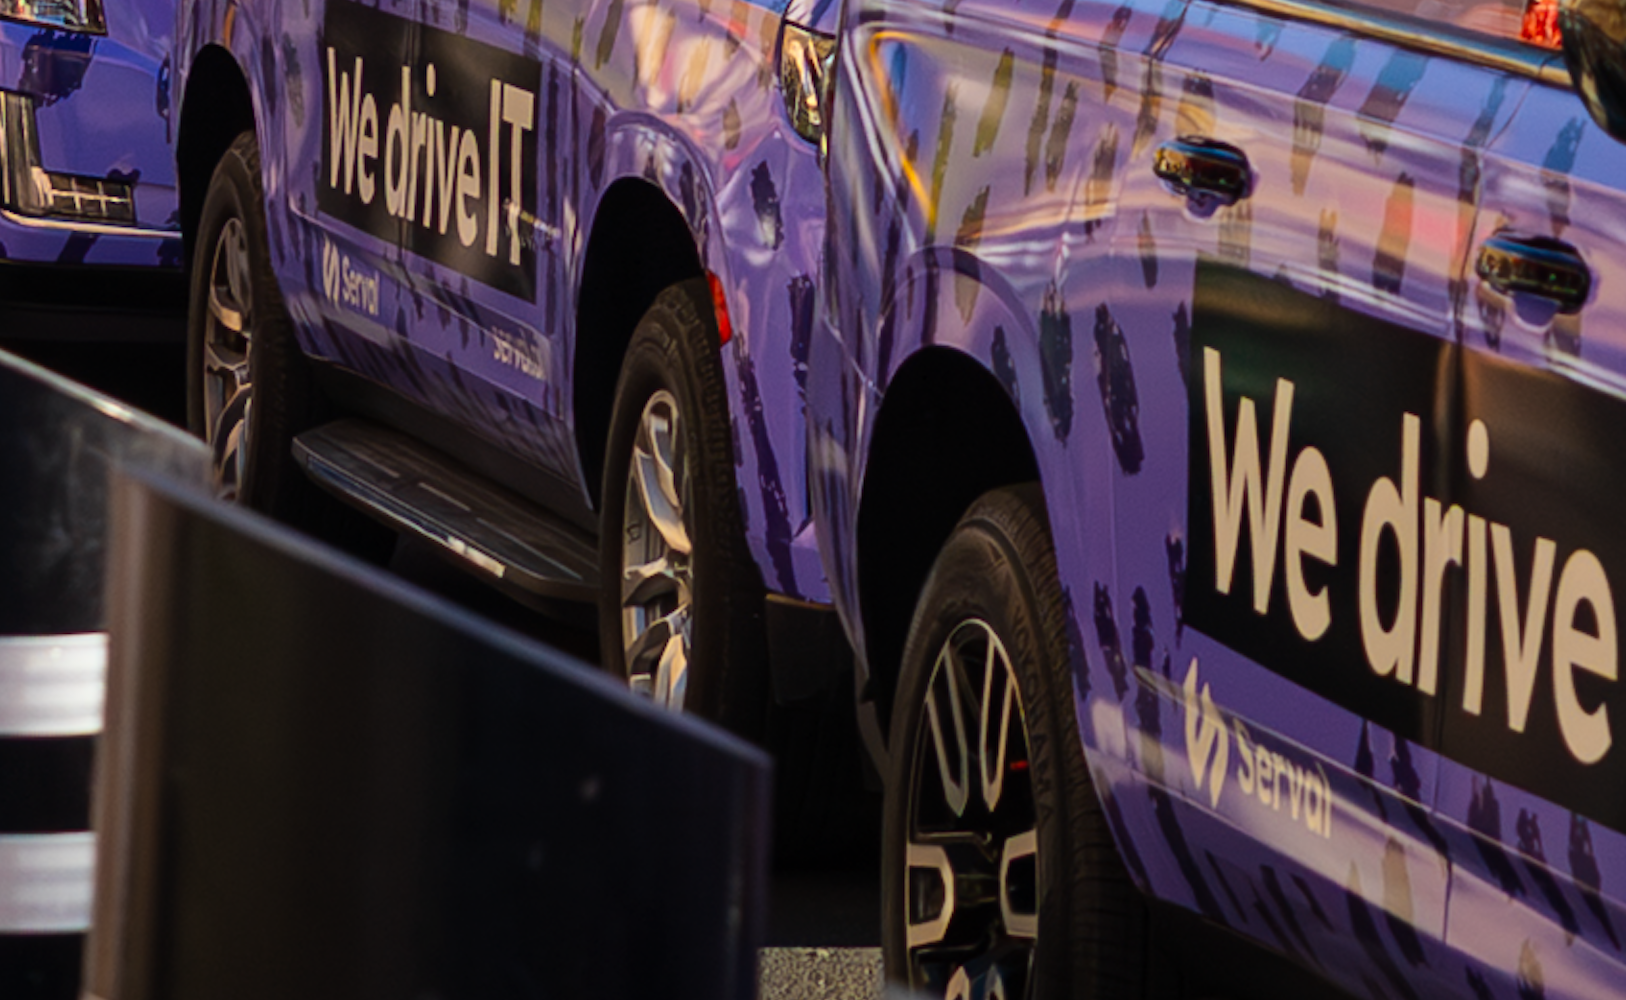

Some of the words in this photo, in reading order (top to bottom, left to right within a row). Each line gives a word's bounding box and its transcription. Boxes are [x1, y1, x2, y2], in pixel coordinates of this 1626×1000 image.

[327, 47, 379, 205] We
[385, 63, 480, 247] drive
[485, 78, 534, 267] IT
[1204, 346, 1337, 642] We
[1358, 411, 1618, 766] drive
[1233, 718, 1332, 840] Serval
